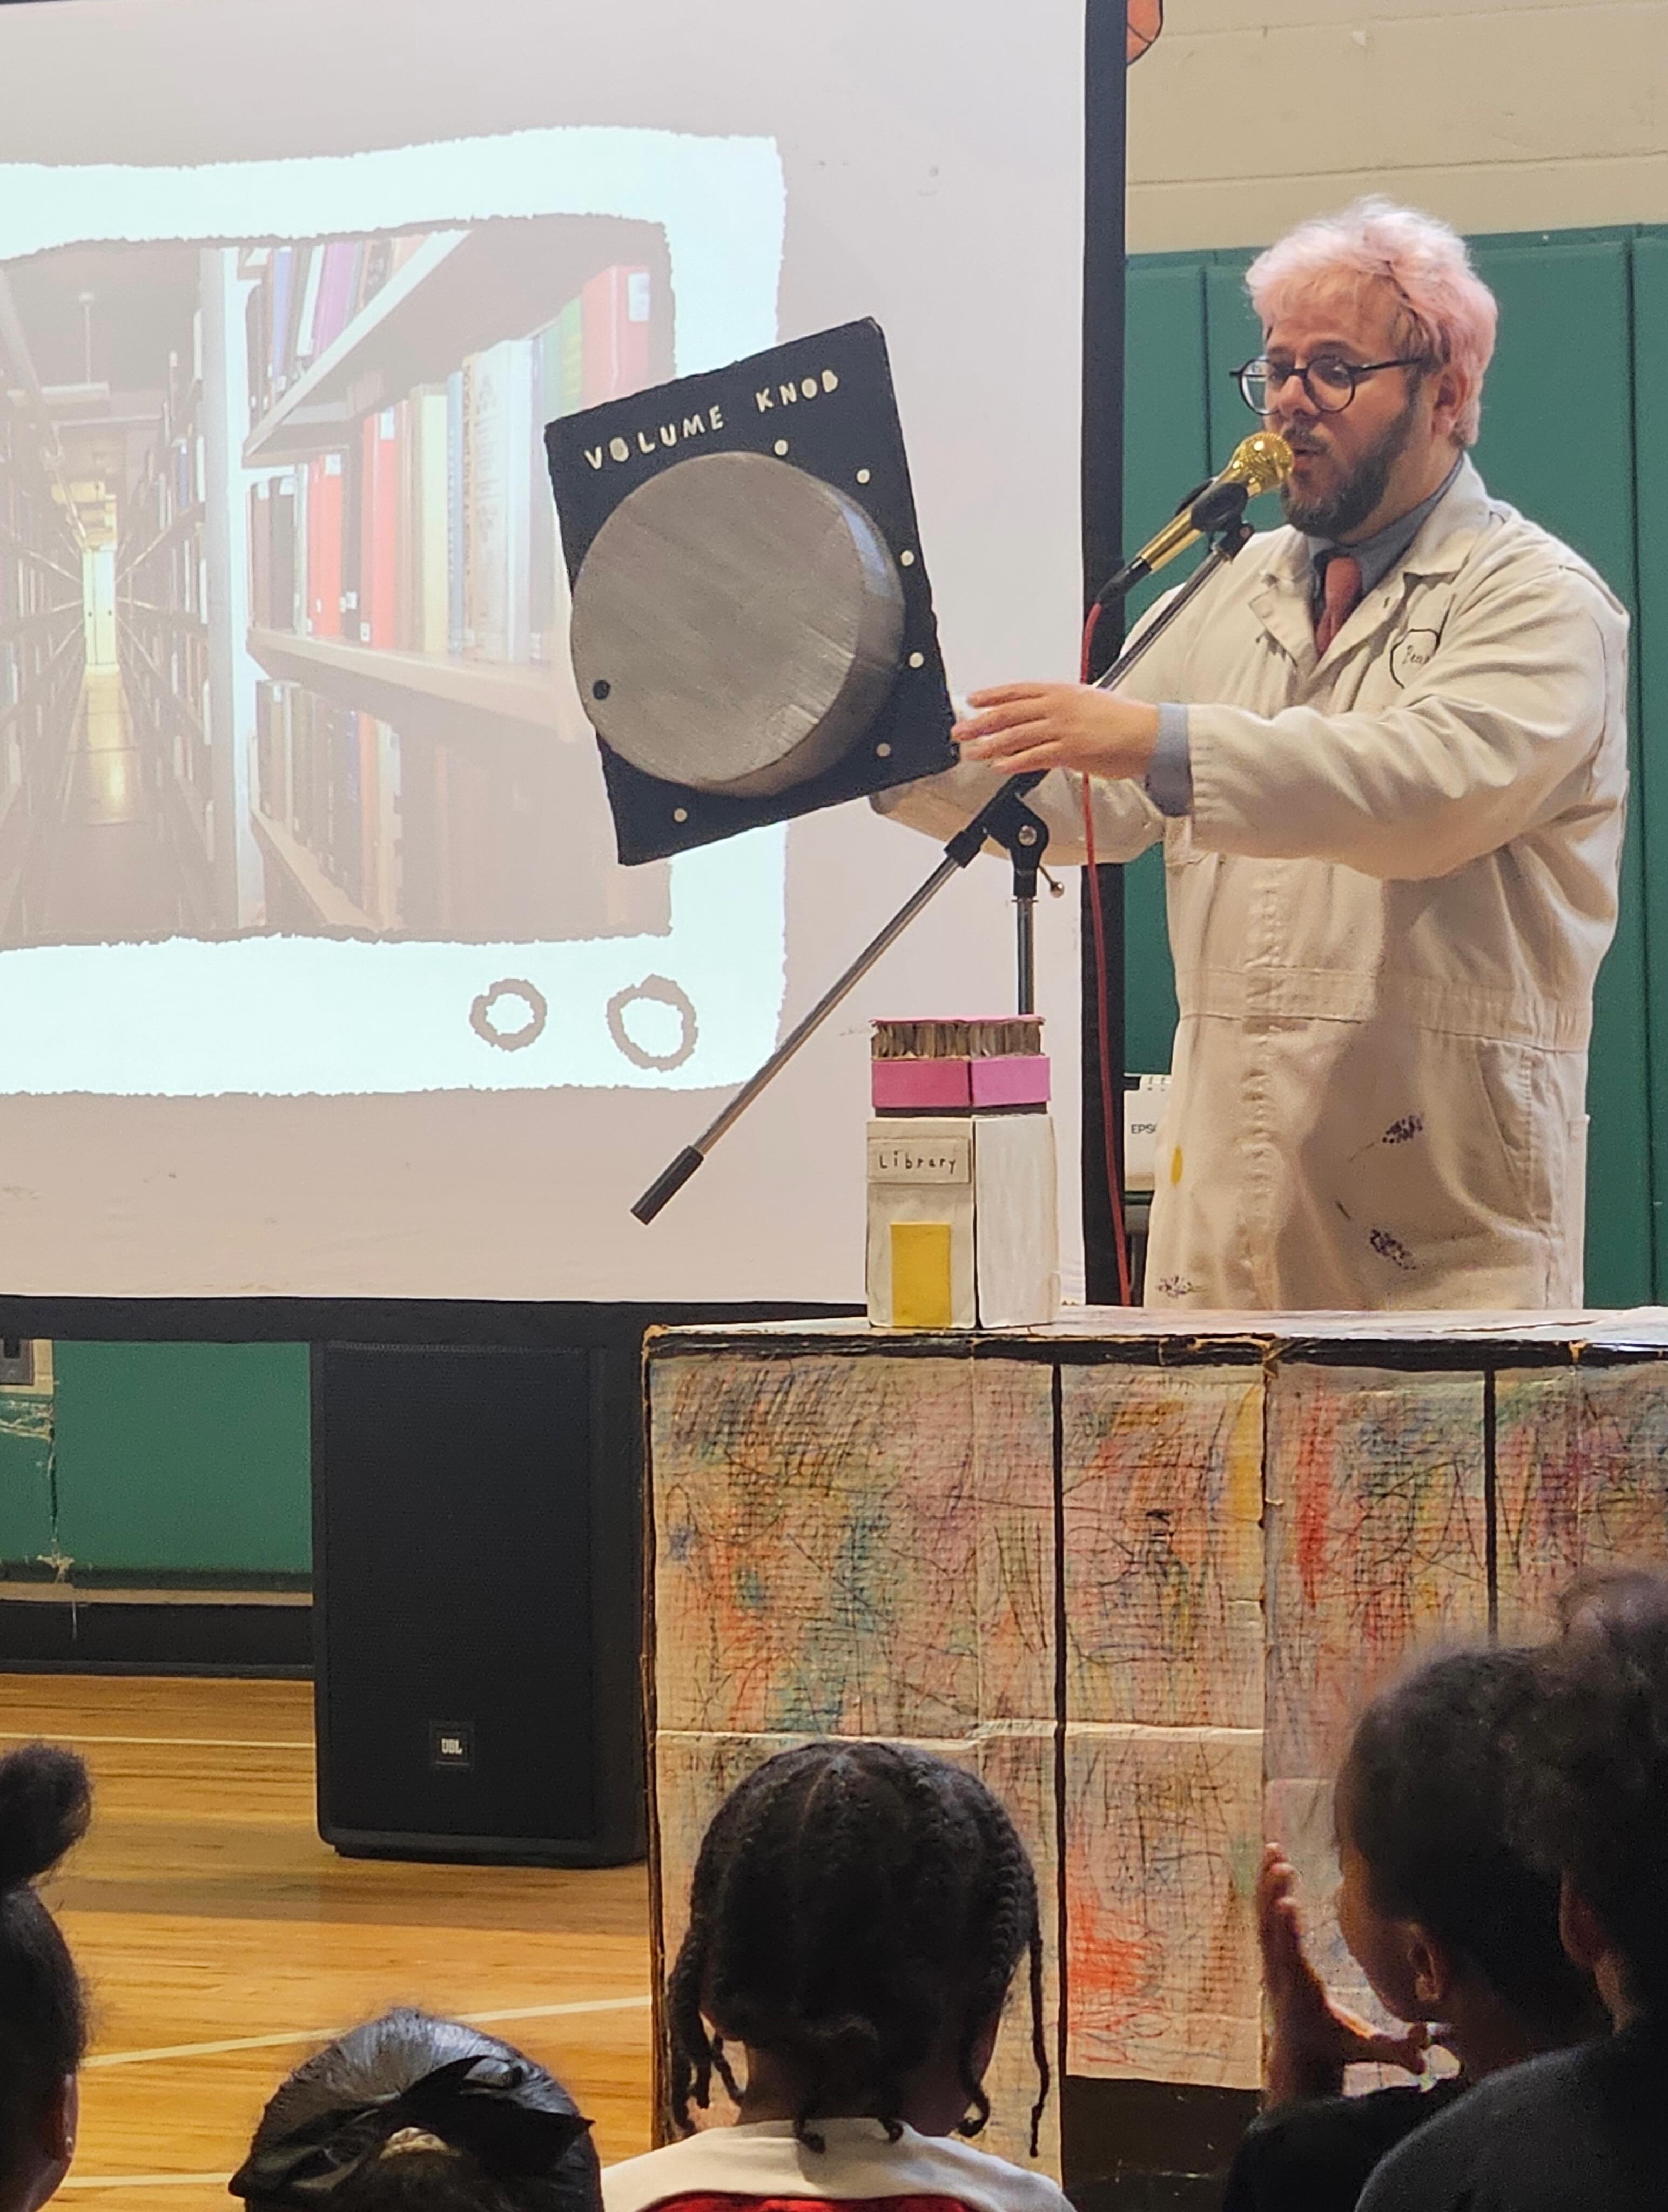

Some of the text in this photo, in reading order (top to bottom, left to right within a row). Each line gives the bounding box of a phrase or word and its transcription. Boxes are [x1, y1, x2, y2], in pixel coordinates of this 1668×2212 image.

[584, 369, 839, 469] VOLUME KNOB
[879, 1150, 956, 1175] Library
[441, 1738, 462, 1754] JBL
